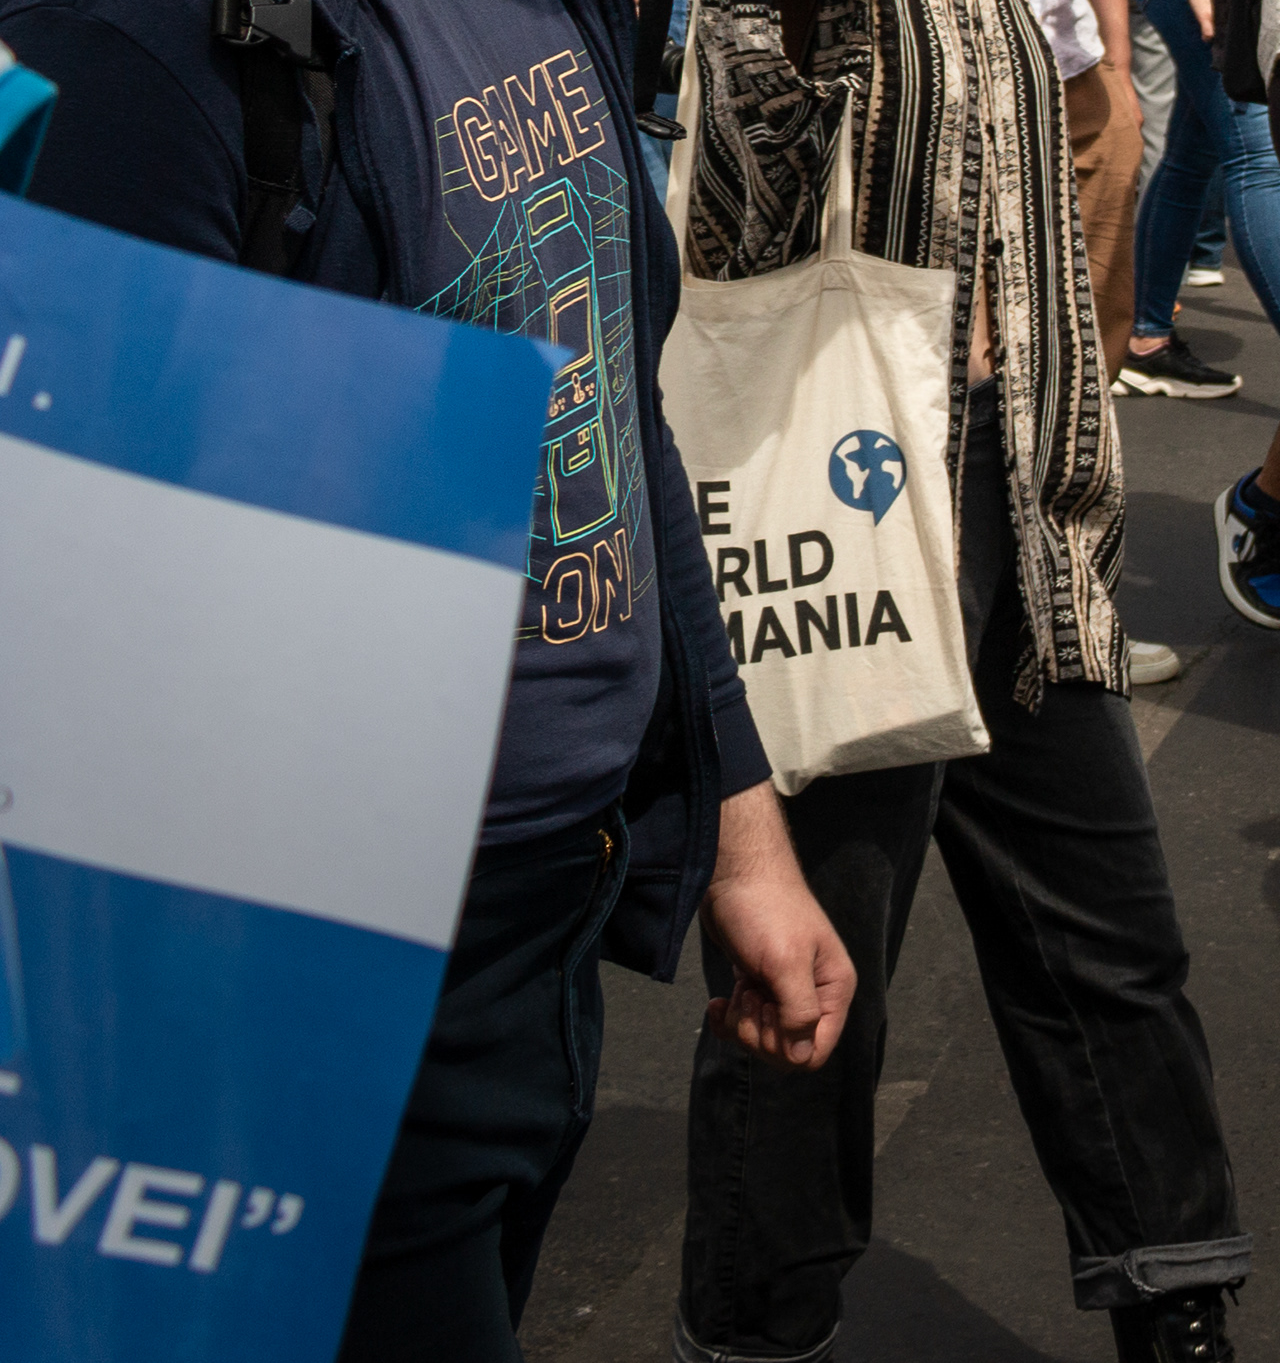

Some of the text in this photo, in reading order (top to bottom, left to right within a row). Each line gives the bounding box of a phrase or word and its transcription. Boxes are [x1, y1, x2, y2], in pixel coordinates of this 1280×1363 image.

[453, 49, 606, 202] GAME
[696, 480, 732, 537] E
[716, 529, 835, 603] RLD
[541, 527, 632, 645] ON
[0, 1136, 305, 1276] VEI”
